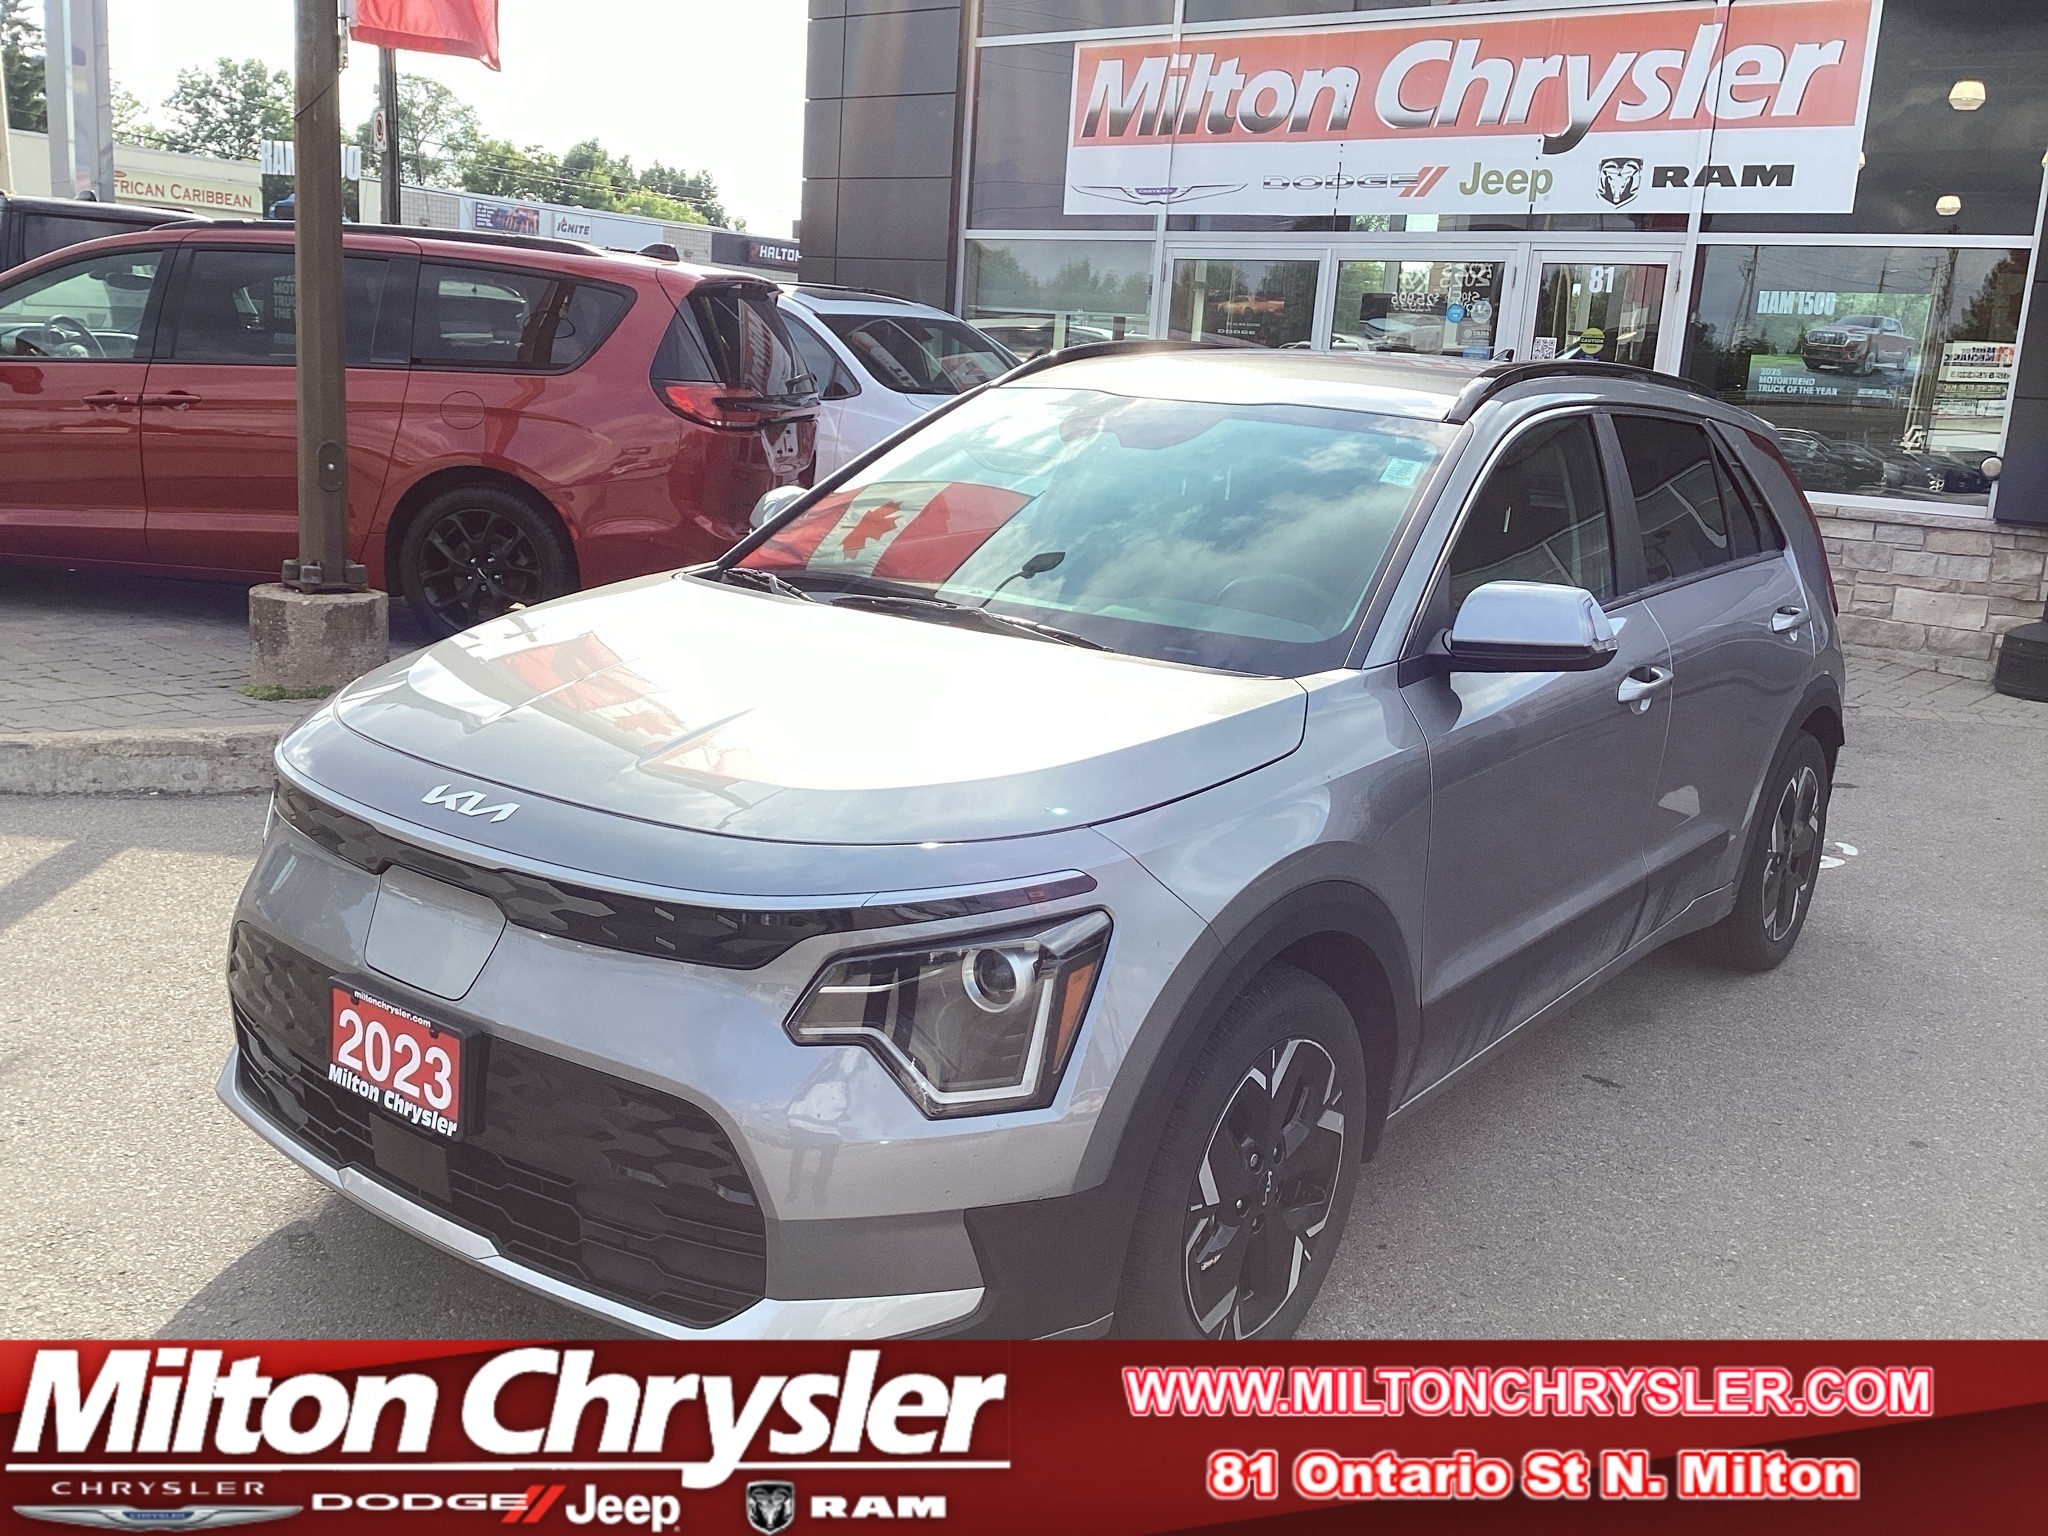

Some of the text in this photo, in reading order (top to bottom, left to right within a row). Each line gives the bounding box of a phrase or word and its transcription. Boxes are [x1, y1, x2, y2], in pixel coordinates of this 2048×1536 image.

[1080, 23, 1846, 155] Milton Chrysler
[1263, 174, 1420, 190] DODGE
[1459, 162, 1553, 202] Jeep
[1651, 165, 1795, 188] RAM
[114, 179, 252, 208] FRICAN CARIBBEAN
[557, 222, 590, 235] IGNITE
[1588, 265, 1615, 293] 81
[1757, 291, 1837, 315] RAM 1500
[1758, 376, 1816, 386] MOTORTREND
[1760, 368, 1782, 376] 2025
[1758, 384, 1838, 396] TRUCK OF THE YEAR
[421, 783, 520, 823] KIA
[354, 990, 431, 1028] miltonchrysler.com
[338, 1008, 452, 1110] 2023
[328, 1063, 457, 1137] Milton Chrysler
